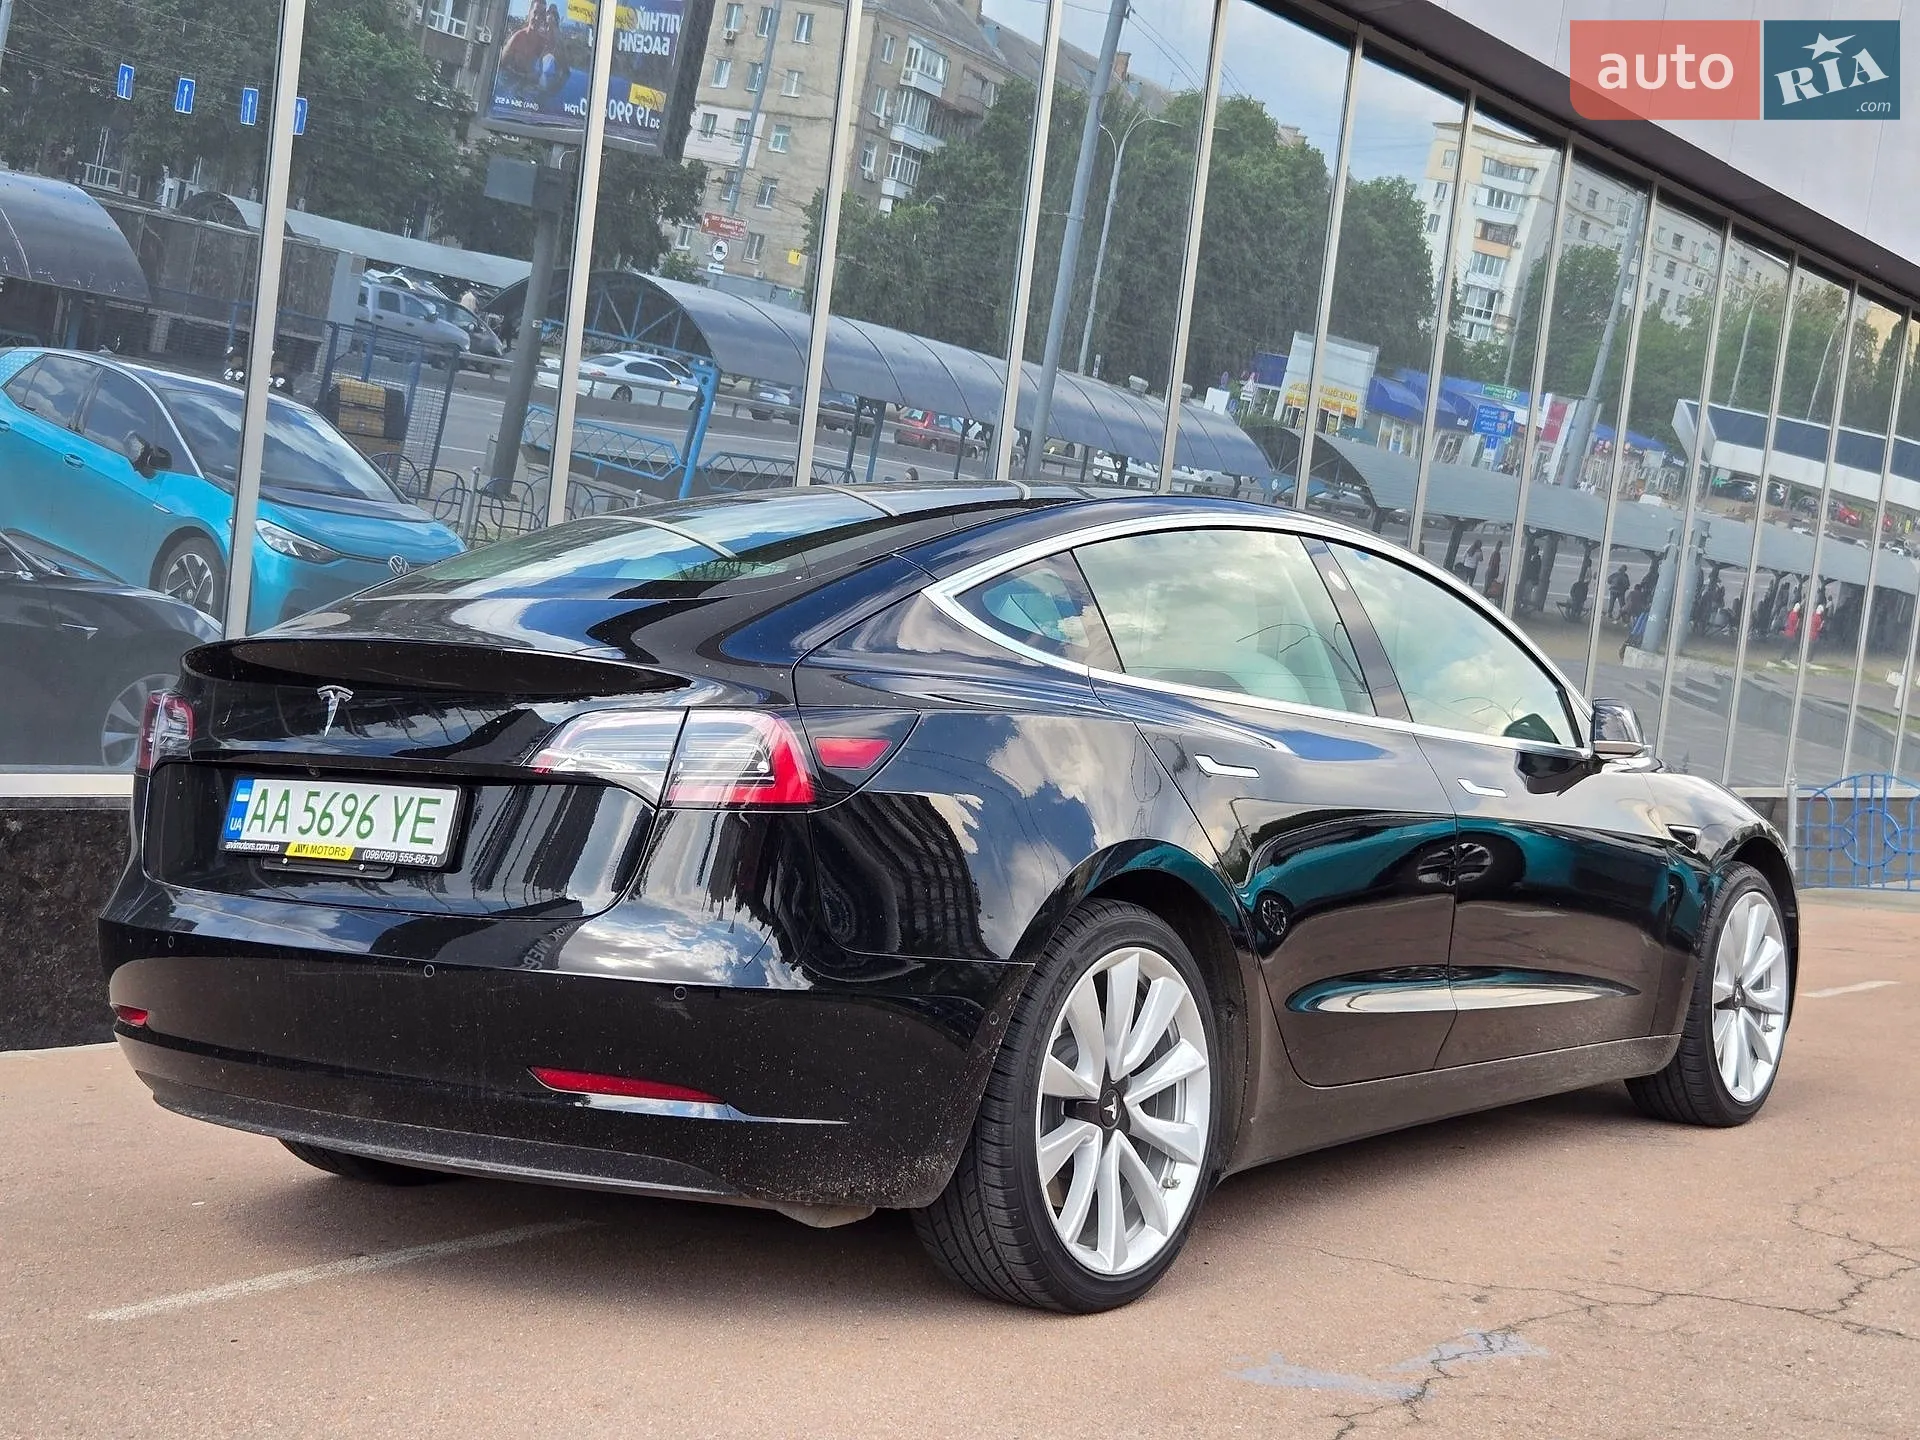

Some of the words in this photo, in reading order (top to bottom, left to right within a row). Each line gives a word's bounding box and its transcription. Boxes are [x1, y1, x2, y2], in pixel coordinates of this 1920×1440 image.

[246, 788, 291, 834] AA
[298, 790, 380, 841] 5696
[392, 795, 442, 845] YE
[230, 817, 243, 831] UA
[309, 844, 347, 857] MOTORS
